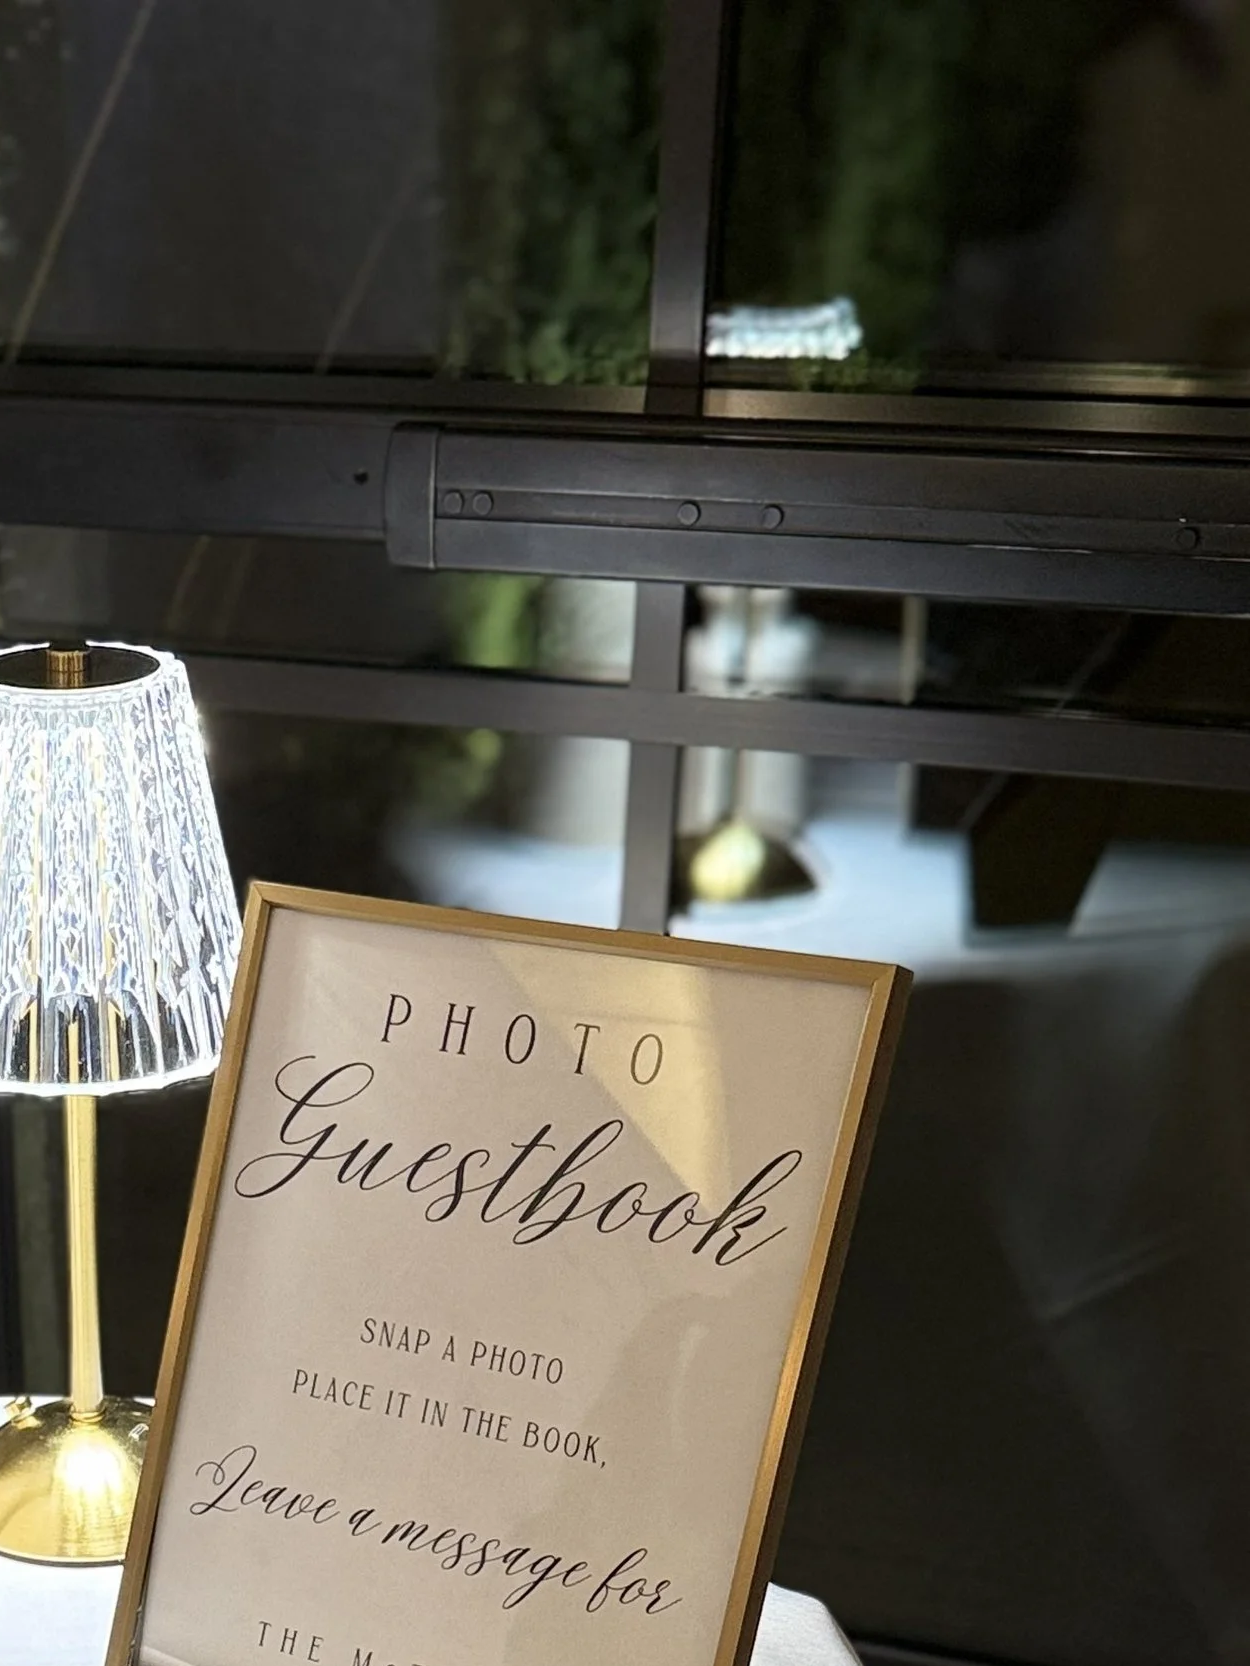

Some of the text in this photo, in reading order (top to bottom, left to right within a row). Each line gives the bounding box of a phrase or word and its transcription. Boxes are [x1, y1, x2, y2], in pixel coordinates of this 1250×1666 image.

[379, 992, 665, 1087] PHOTO
[232, 1053, 804, 1268] Guestbook
[358, 1316, 565, 1386] SNAP A PHOTO
[291, 1367, 609, 1471] PLACE IT IN THE BOOK,
[188, 1443, 684, 1616] Leave a message for
[257, 1619, 325, 1664] THE
